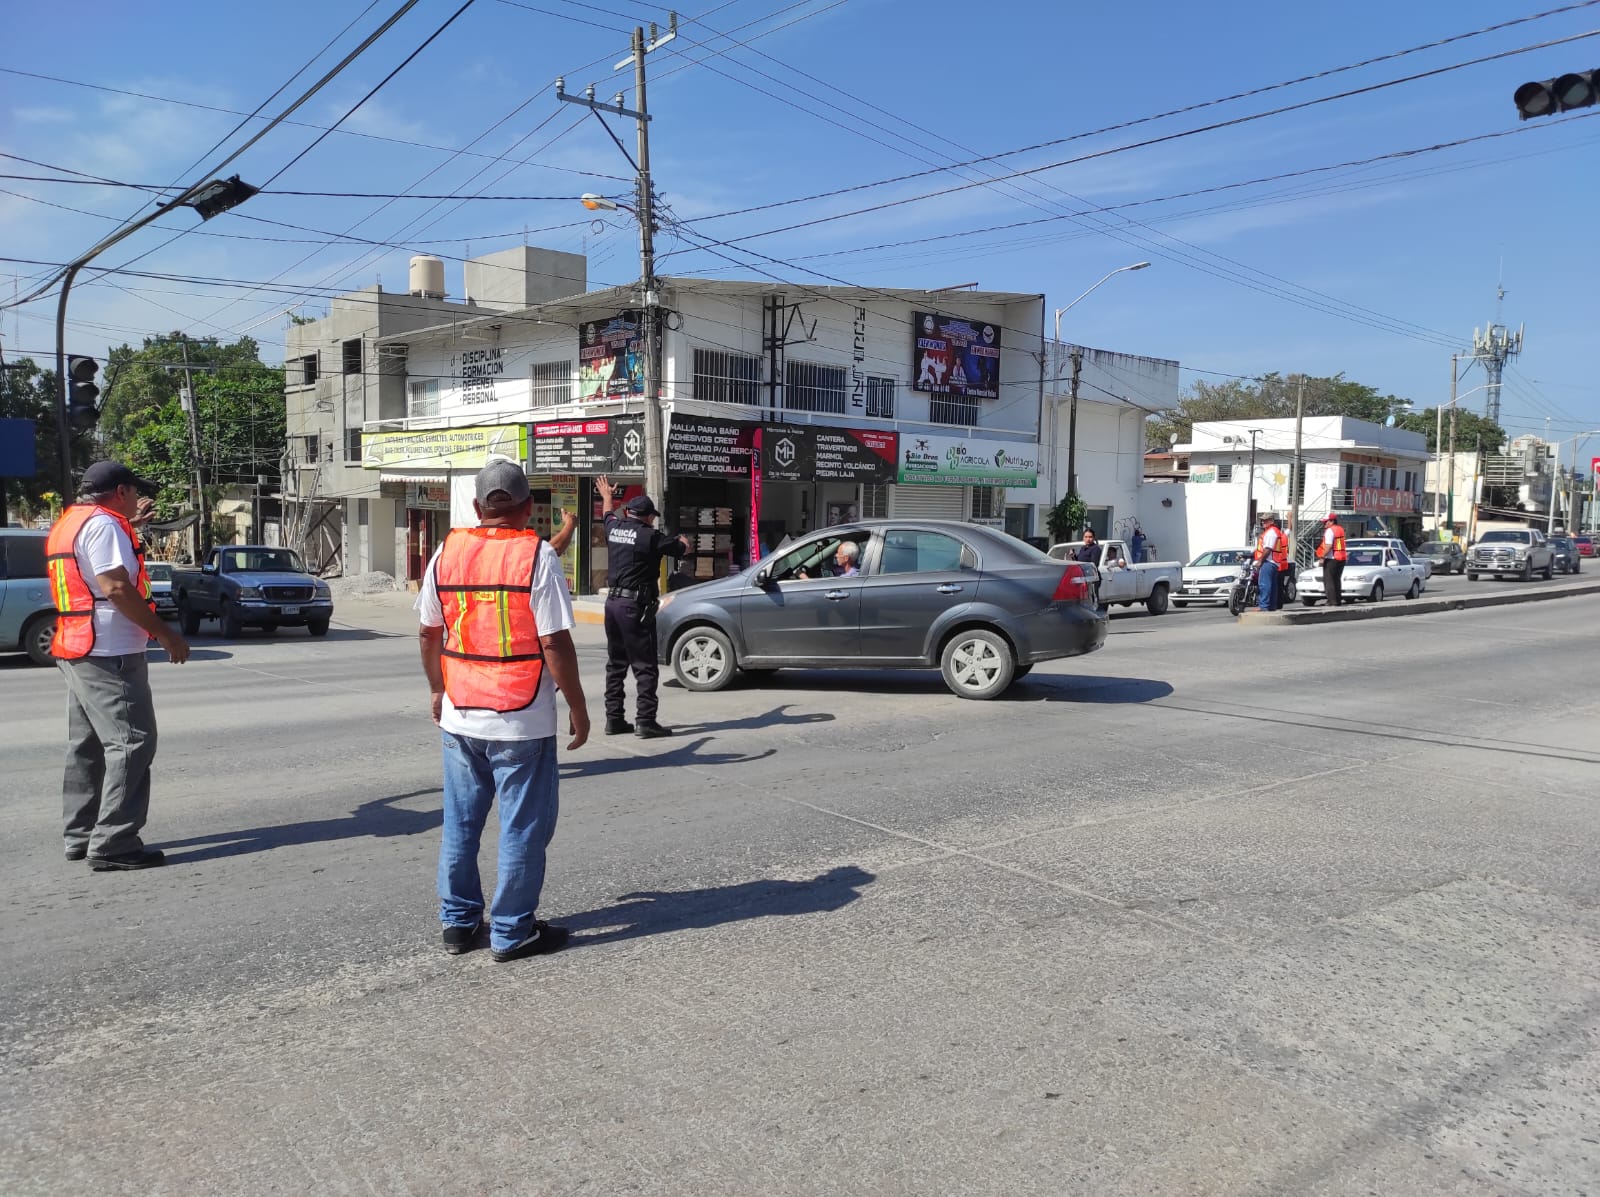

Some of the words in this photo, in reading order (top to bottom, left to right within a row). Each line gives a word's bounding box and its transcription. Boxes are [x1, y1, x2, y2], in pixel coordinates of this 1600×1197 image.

[463, 348, 501, 365] DISCIPLINA
[463, 361, 503, 377] FORMACION
[463, 390, 499, 405] PERSONAL
[671, 424, 695, 433] MALLA
[698, 426, 717, 435] PARA
[669, 433, 712, 443] ADHESIVOS
[714, 436, 738, 445] CREST
[816, 434, 846, 443] CANTERA
[669, 443, 711, 453] VENECIANO
[816, 443, 858, 453] TRAVERTINOS
[816, 452, 844, 461] MARMOL
[960, 456, 990, 465] AGRICOLA
[668, 462, 698, 472] JUNTAS
[707, 465, 747, 473] BOQUILLAS
[816, 461, 841, 469] RECINTO
[843, 461, 876, 471] VOLCÁNICO
[816, 469, 838, 478] PIEDRA
